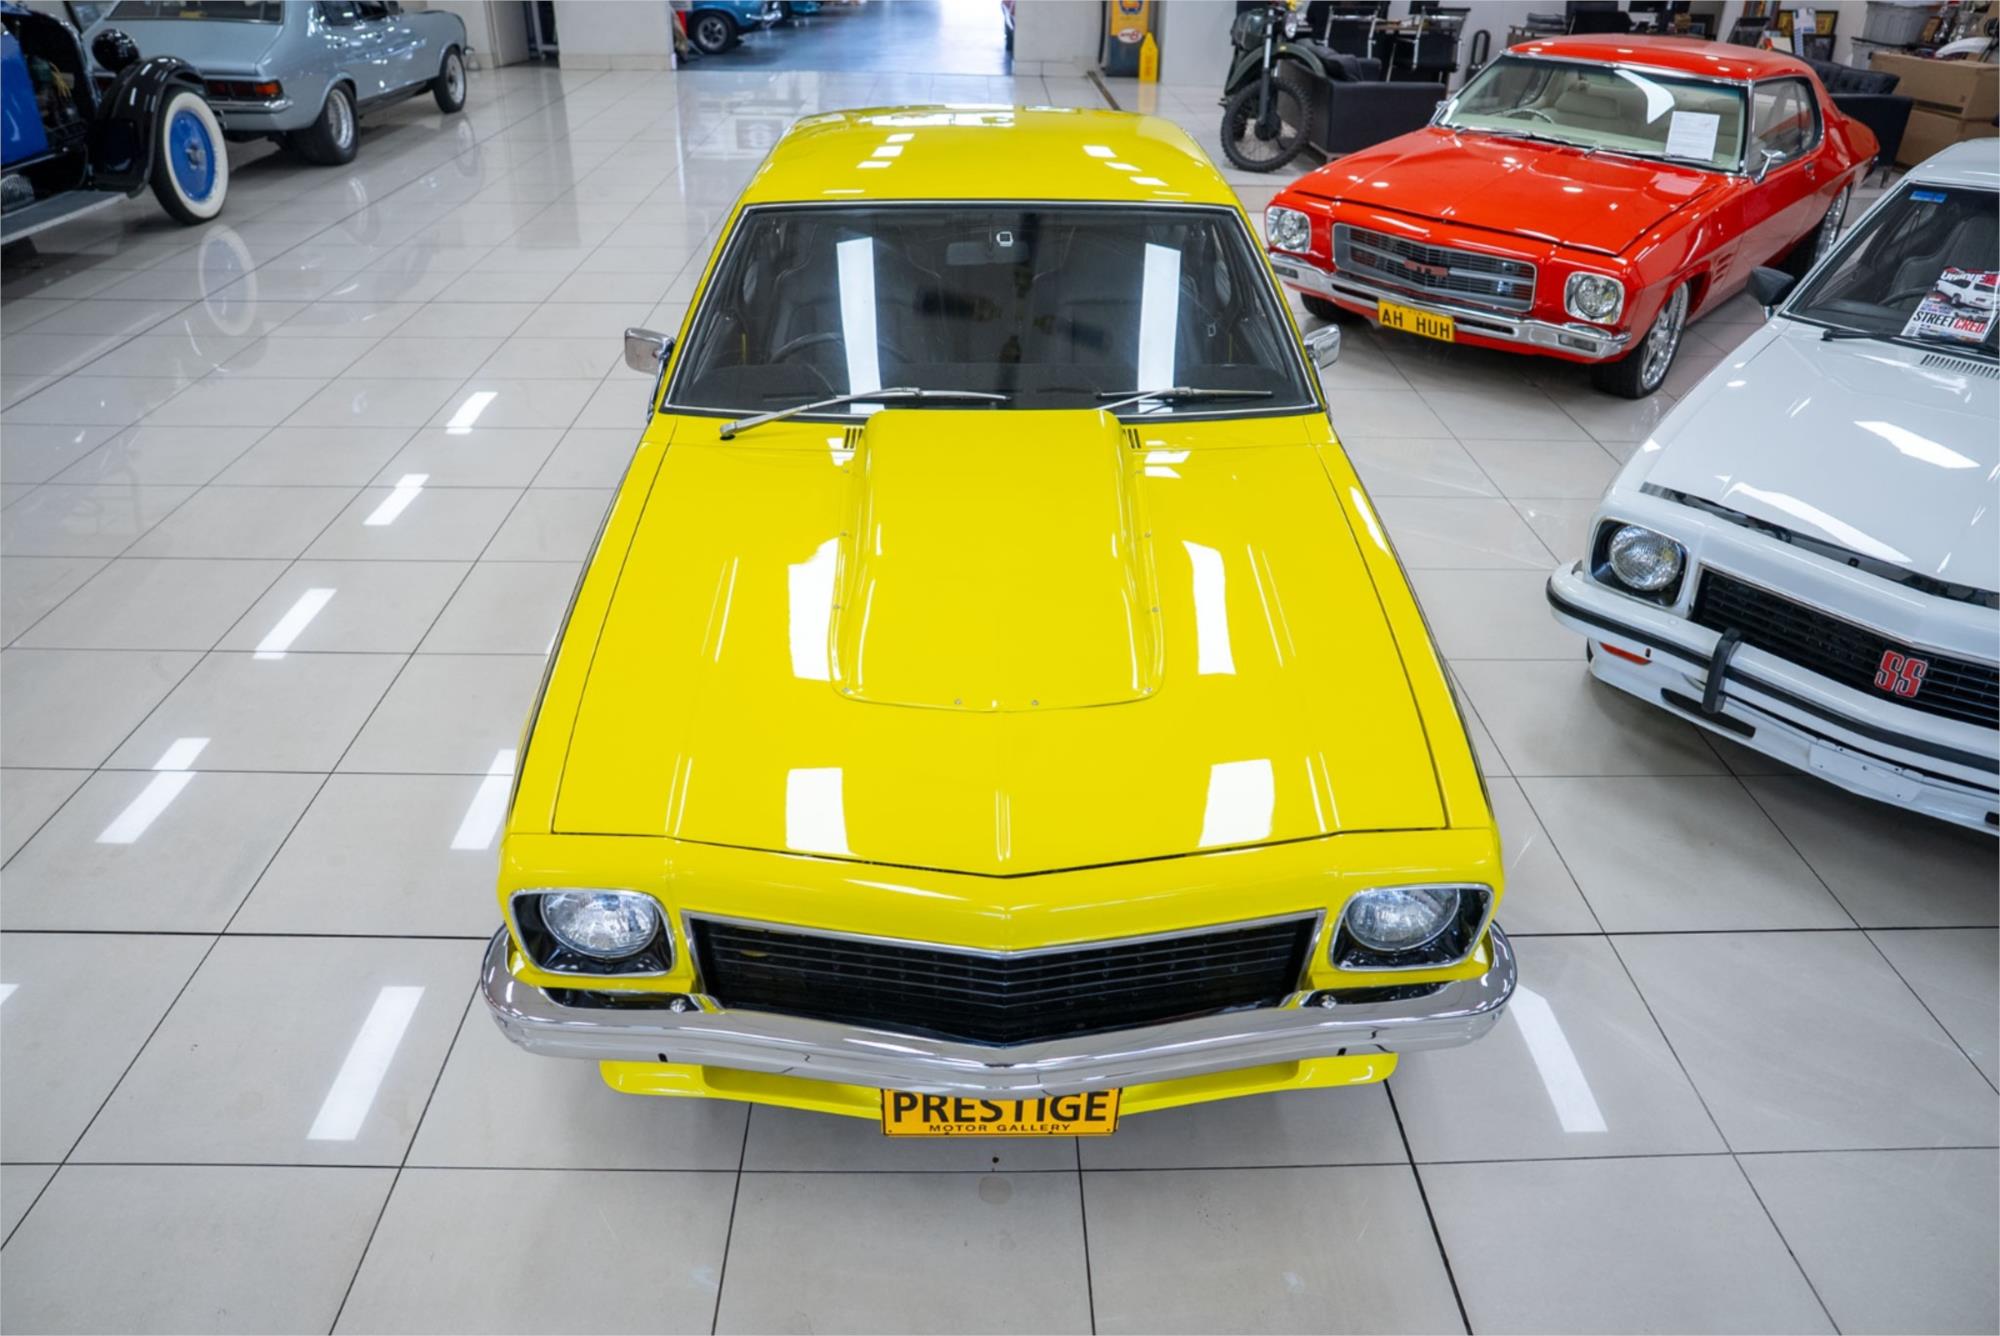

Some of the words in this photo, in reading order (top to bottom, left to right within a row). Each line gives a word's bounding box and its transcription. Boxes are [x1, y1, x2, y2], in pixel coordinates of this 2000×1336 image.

[1382, 308, 1403, 328] AH
[1416, 316, 1450, 339] HUH
[1874, 649, 1928, 698] SS
[893, 1091, 1109, 1123] PRESTIGE
[929, 1123, 988, 1132] MOTOR
[996, 1123, 1071, 1132] GALLERY
